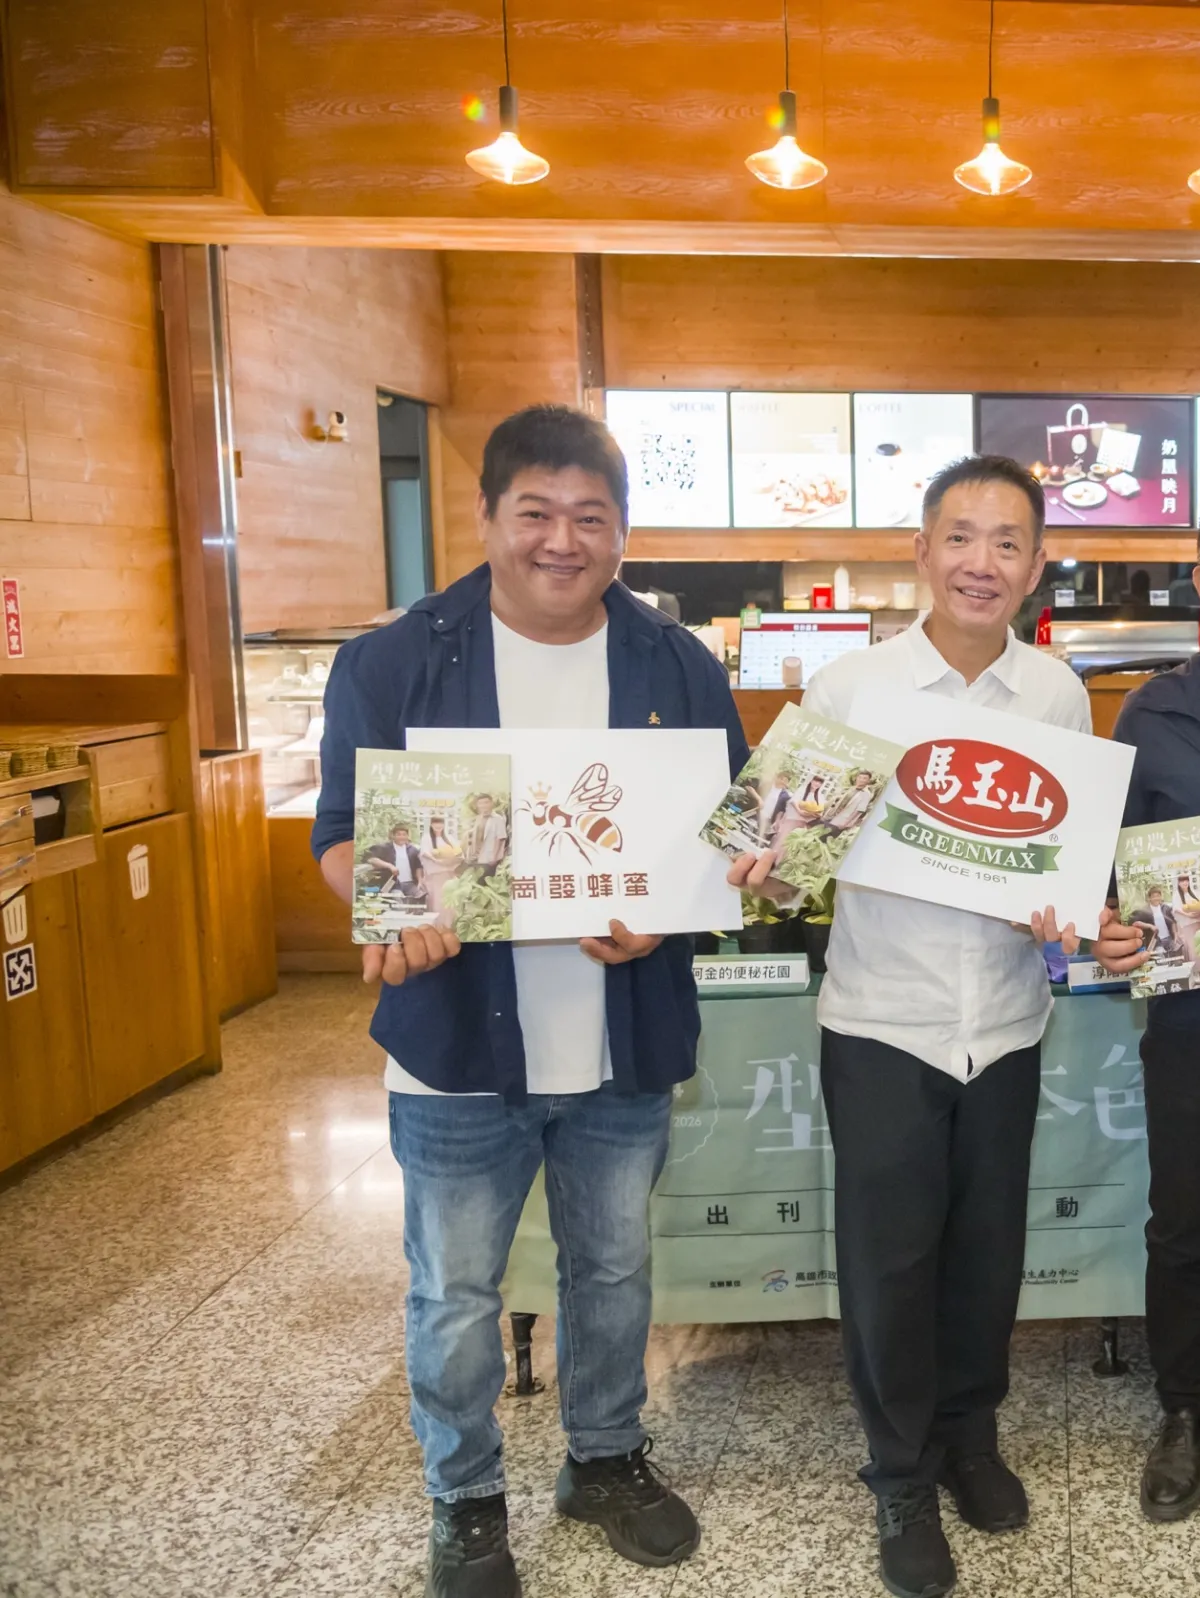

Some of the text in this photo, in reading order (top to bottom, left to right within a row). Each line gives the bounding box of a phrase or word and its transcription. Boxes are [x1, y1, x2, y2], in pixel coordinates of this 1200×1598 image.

[916, 744, 1054, 822] 馬玉山
[901, 823, 1036, 870] GREENMAX
[920, 856, 1008, 885] SINCE 1961
